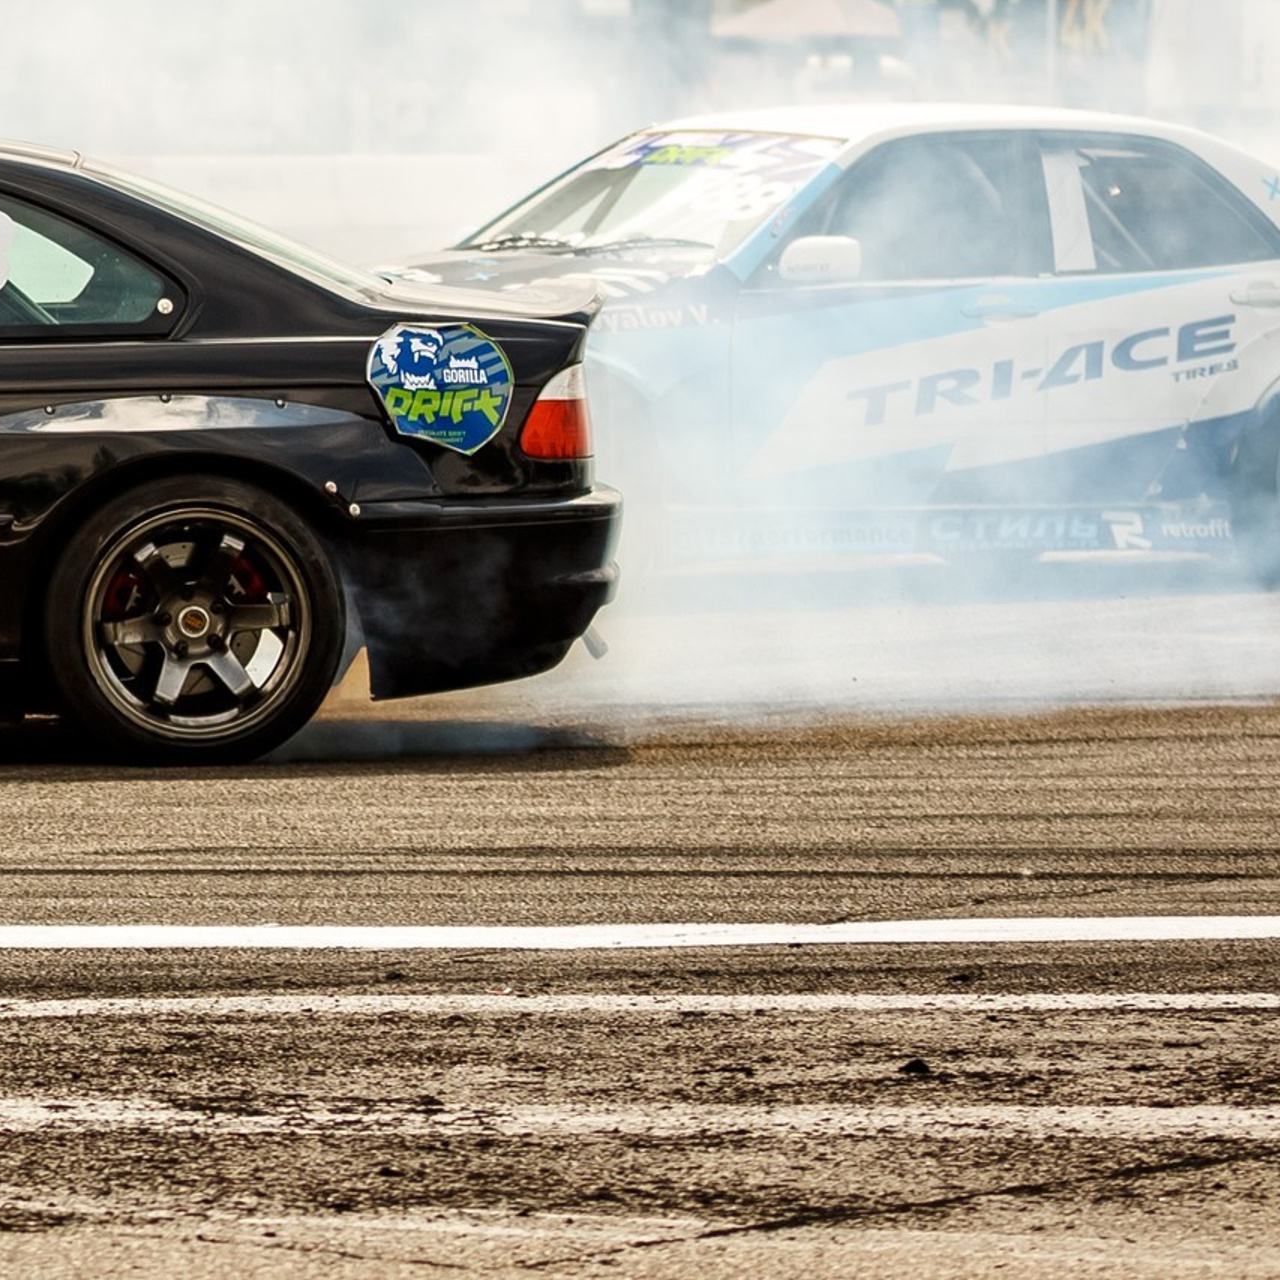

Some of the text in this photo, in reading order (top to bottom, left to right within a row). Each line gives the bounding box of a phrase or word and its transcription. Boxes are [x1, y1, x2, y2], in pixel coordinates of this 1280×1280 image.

[591, 305, 683, 334] yalov
[443, 369, 488, 385] GORILLA
[847, 313, 1236, 426] TRI-ACE
[383, 387, 503, 426] DRIFT
